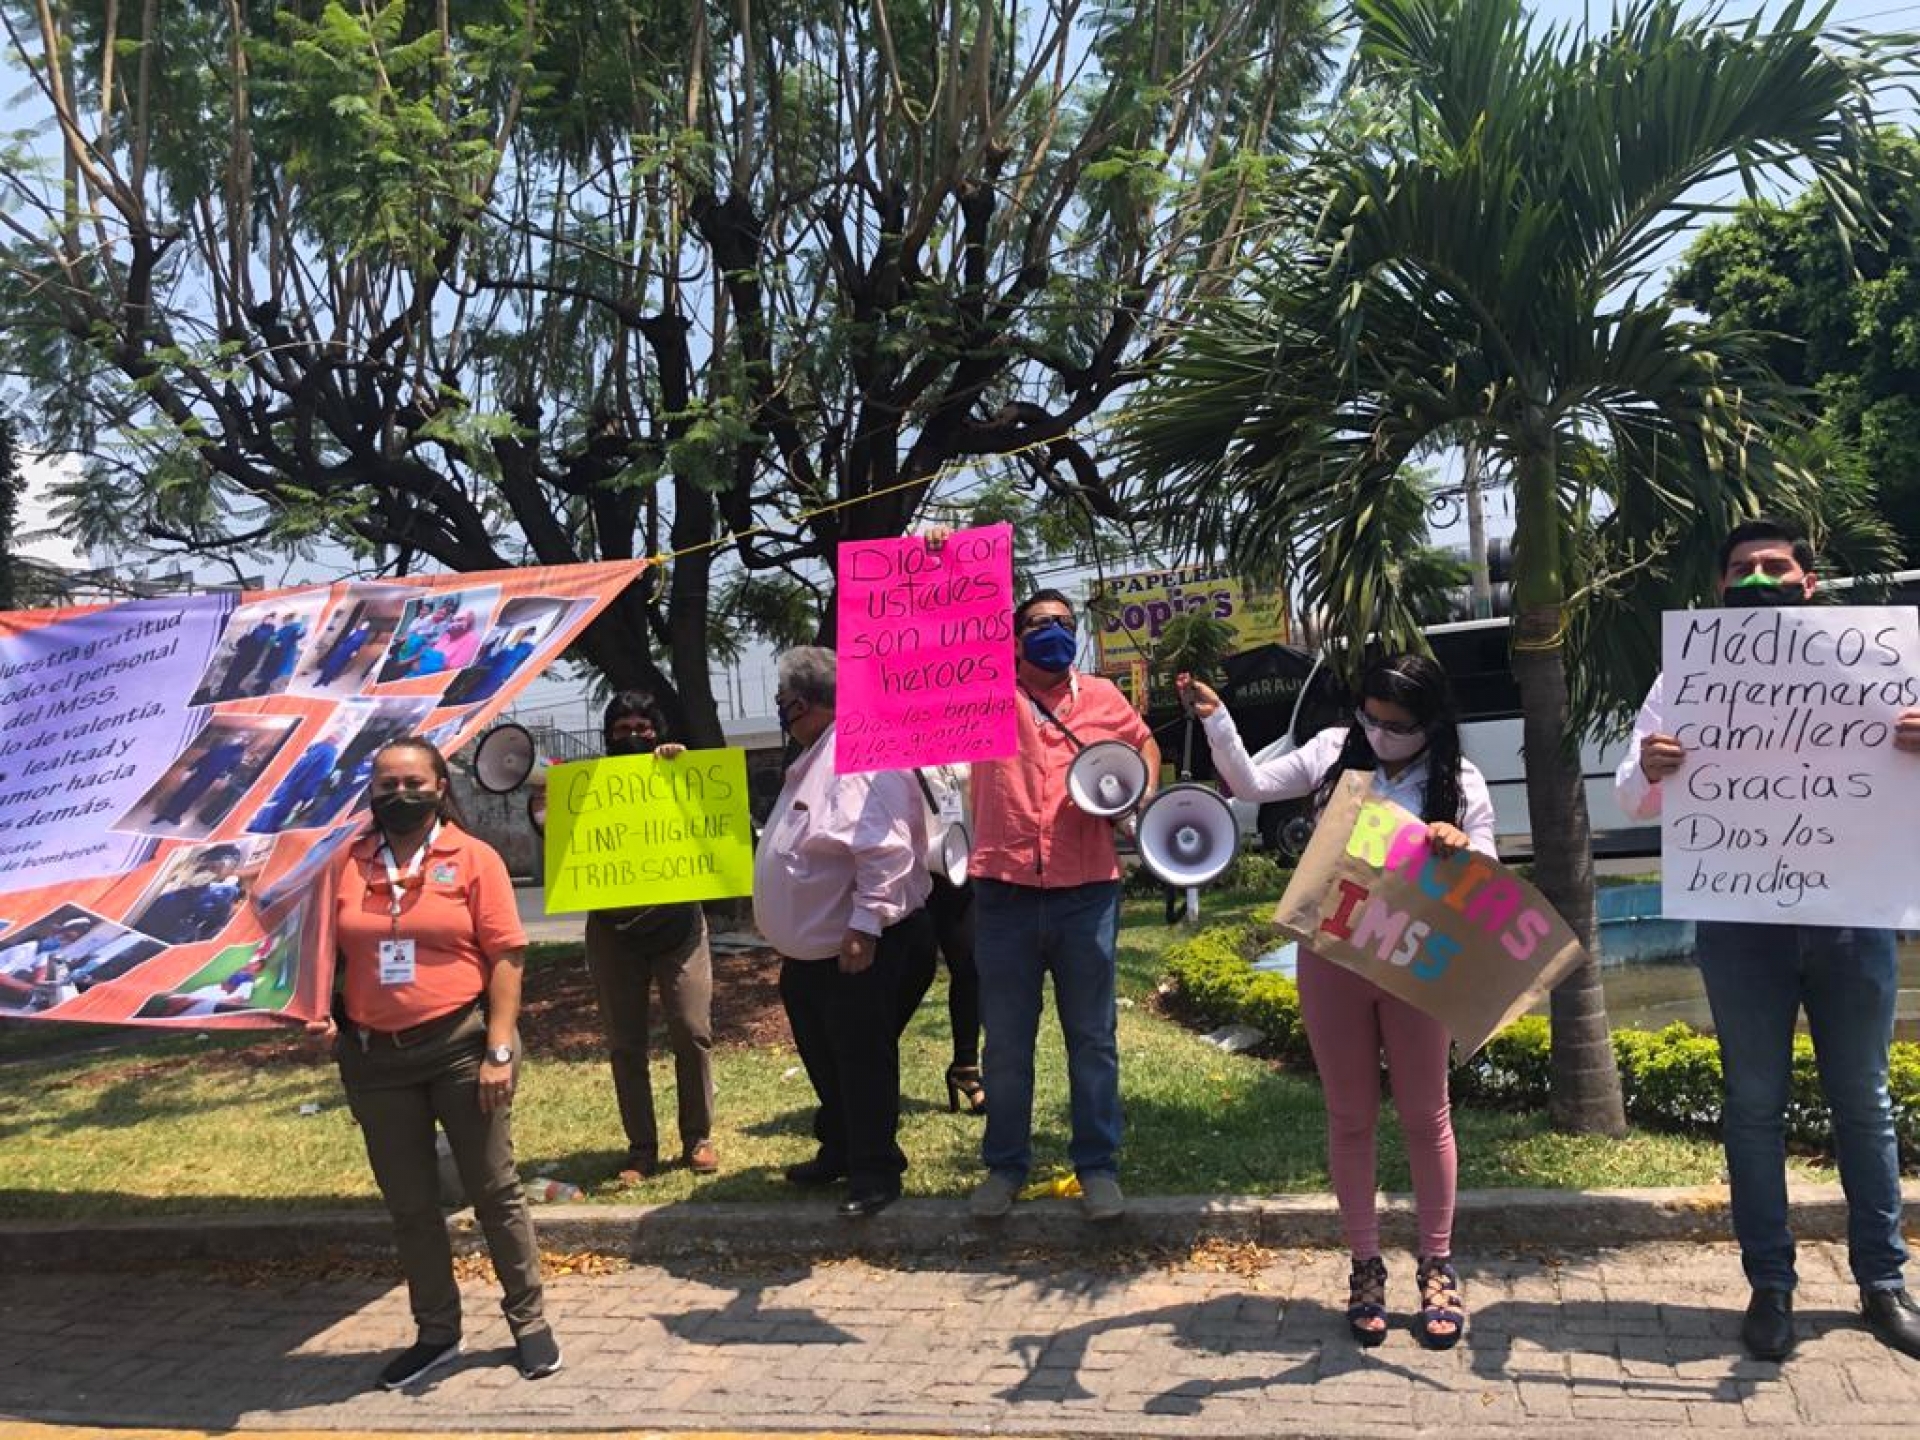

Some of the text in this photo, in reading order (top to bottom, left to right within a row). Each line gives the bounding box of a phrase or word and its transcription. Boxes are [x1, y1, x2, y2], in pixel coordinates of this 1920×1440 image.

[852, 535, 1010, 582] Dios con
[867, 572, 999, 619] ustedes
[0, 609, 186, 680] uestra gratitud
[851, 609, 1012, 659] son unos
[1681, 611, 1901, 667] Médicos
[0, 682, 46, 705] odo
[72, 637, 178, 692] personal
[881, 653, 999, 695] heroes
[2, 704, 43, 731] del
[1673, 671, 1919, 724] Enfermeras
[26, 731, 58, 750] de
[841, 710, 893, 736] Dios
[22, 737, 137, 776] lealtad y
[66, 763, 136, 791] hacia
[567, 764, 733, 814] GRACIAS
[1688, 762, 1873, 802] Gracias
[1673, 812, 1835, 851] Dios los
[565, 851, 723, 891] TRAB SOCIAL
[1687, 855, 1830, 908] bendiga
[1320, 879, 1463, 981] IMSS
